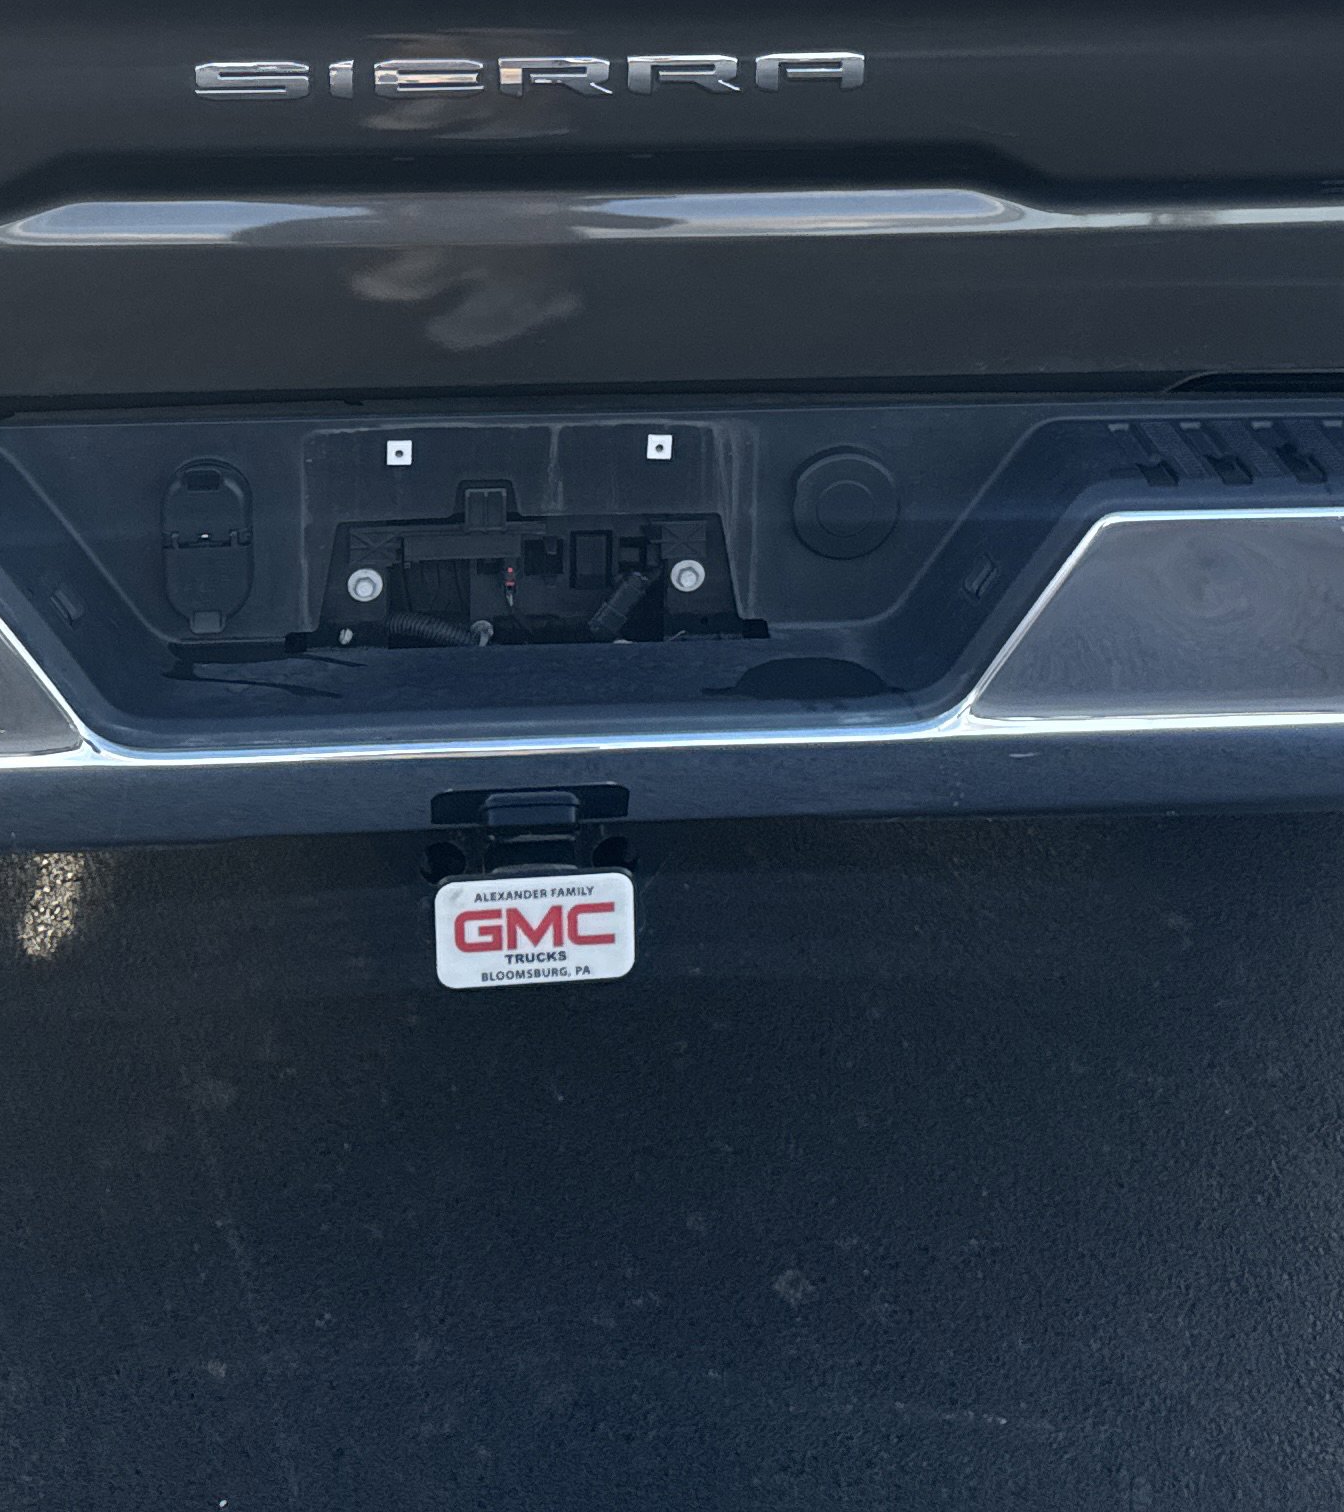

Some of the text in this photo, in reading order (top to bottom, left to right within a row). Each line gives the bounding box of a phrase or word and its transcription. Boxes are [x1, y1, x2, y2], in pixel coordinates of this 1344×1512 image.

[193, 51, 866, 100] SIERRA
[474, 886, 595, 903] ALEXANDER FAMILY
[454, 901, 616, 953] GMC
[503, 950, 567, 965] TRUCKS
[481, 966, 591, 982] BLOOMSBURG, PA
